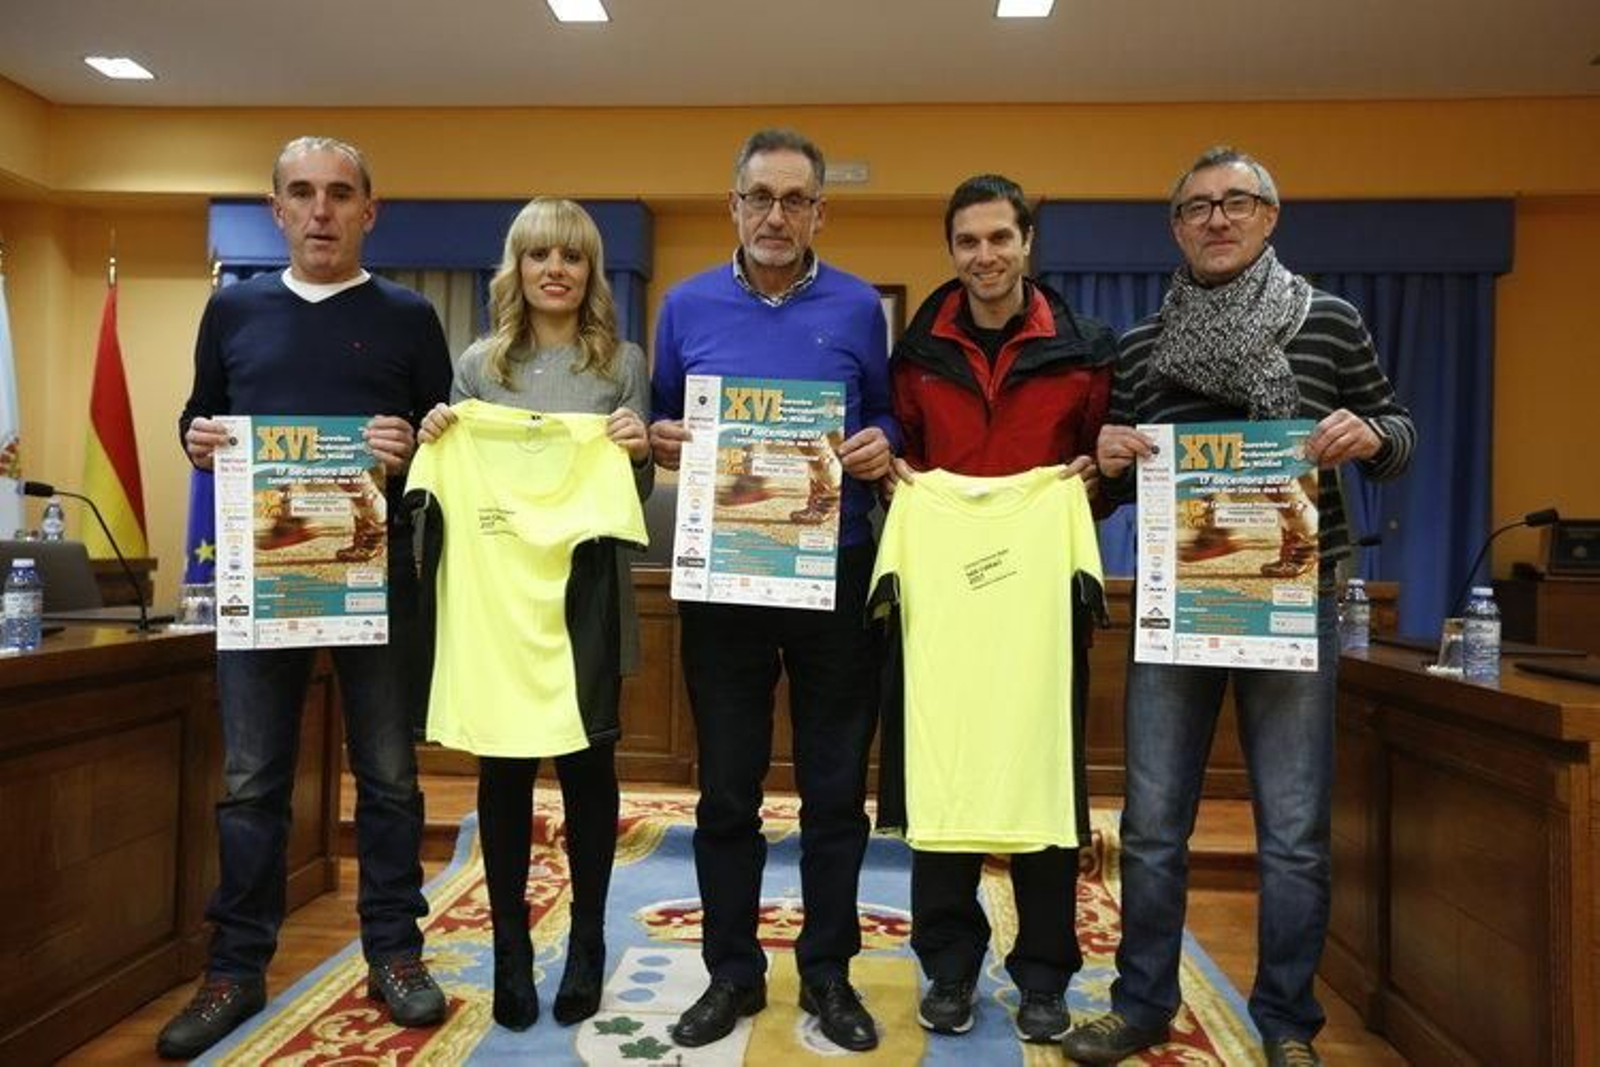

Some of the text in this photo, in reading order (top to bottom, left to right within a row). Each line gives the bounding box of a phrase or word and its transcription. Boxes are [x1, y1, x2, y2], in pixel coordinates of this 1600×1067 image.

[723, 388, 783, 422] XVI
[256, 426, 318, 461] XVI
[1178, 432, 1244, 470] XVI
[276, 467, 287, 477] 17
[340, 466, 362, 476] 2017
[1200, 475, 1212, 485] 17
[1265, 474, 1291, 485] 2017
